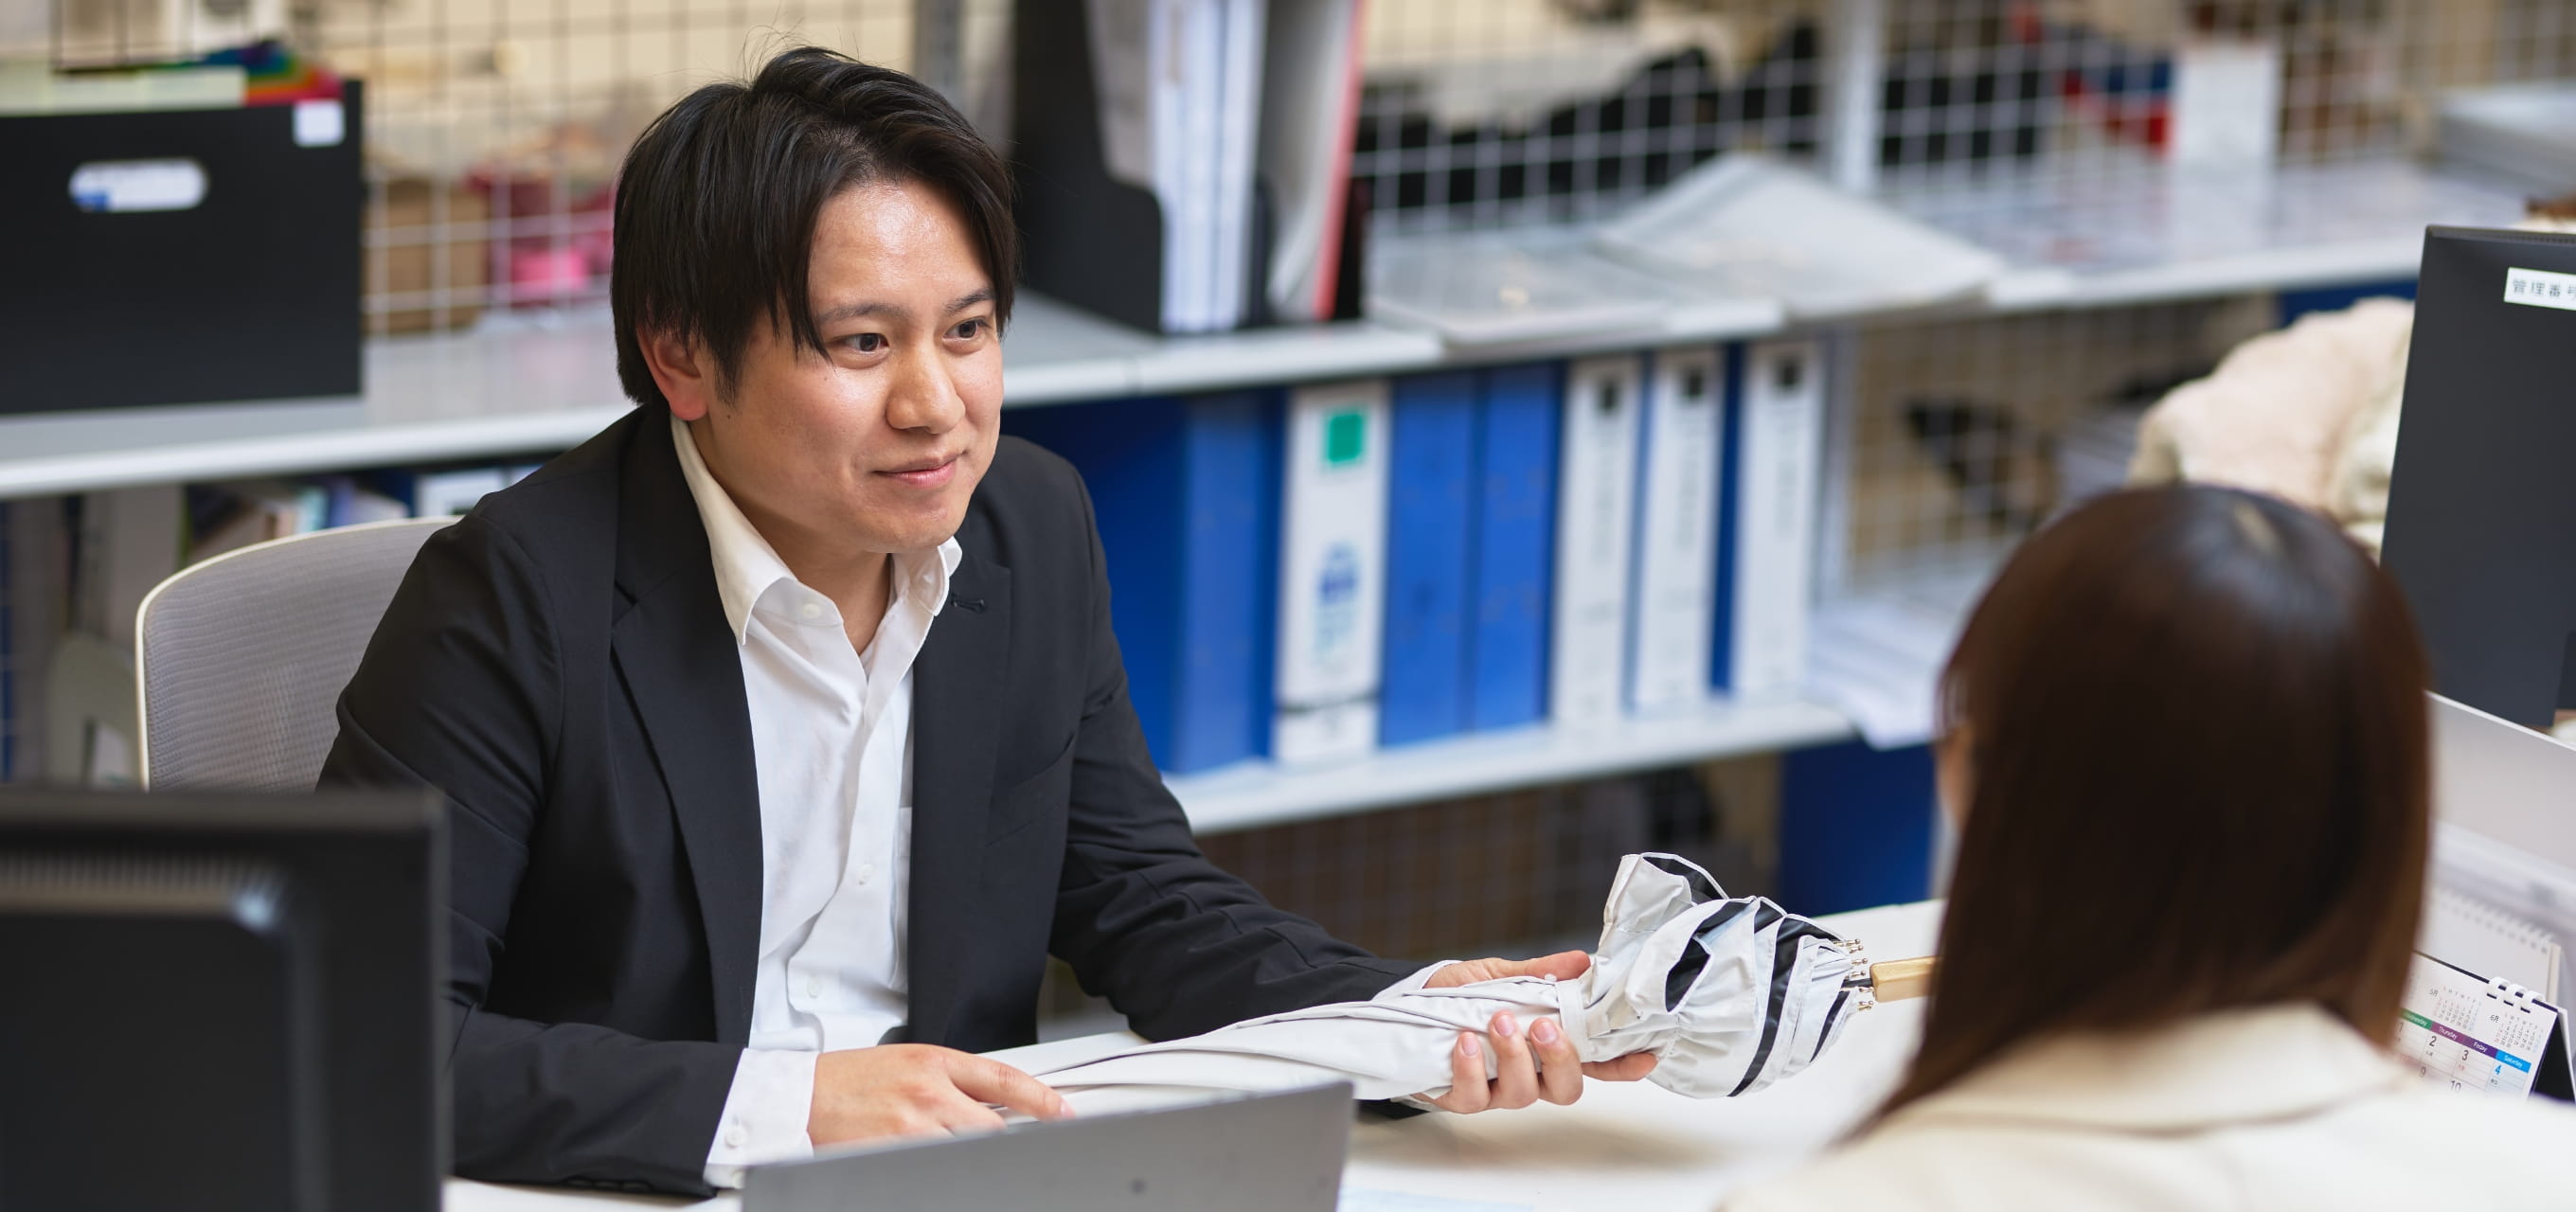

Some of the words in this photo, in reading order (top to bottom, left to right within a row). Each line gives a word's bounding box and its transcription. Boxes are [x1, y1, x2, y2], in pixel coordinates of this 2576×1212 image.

[2429, 1035, 2437, 1047] 2
[2461, 1049, 2469, 1061] 3
[2495, 1064, 2502, 1076] 4
